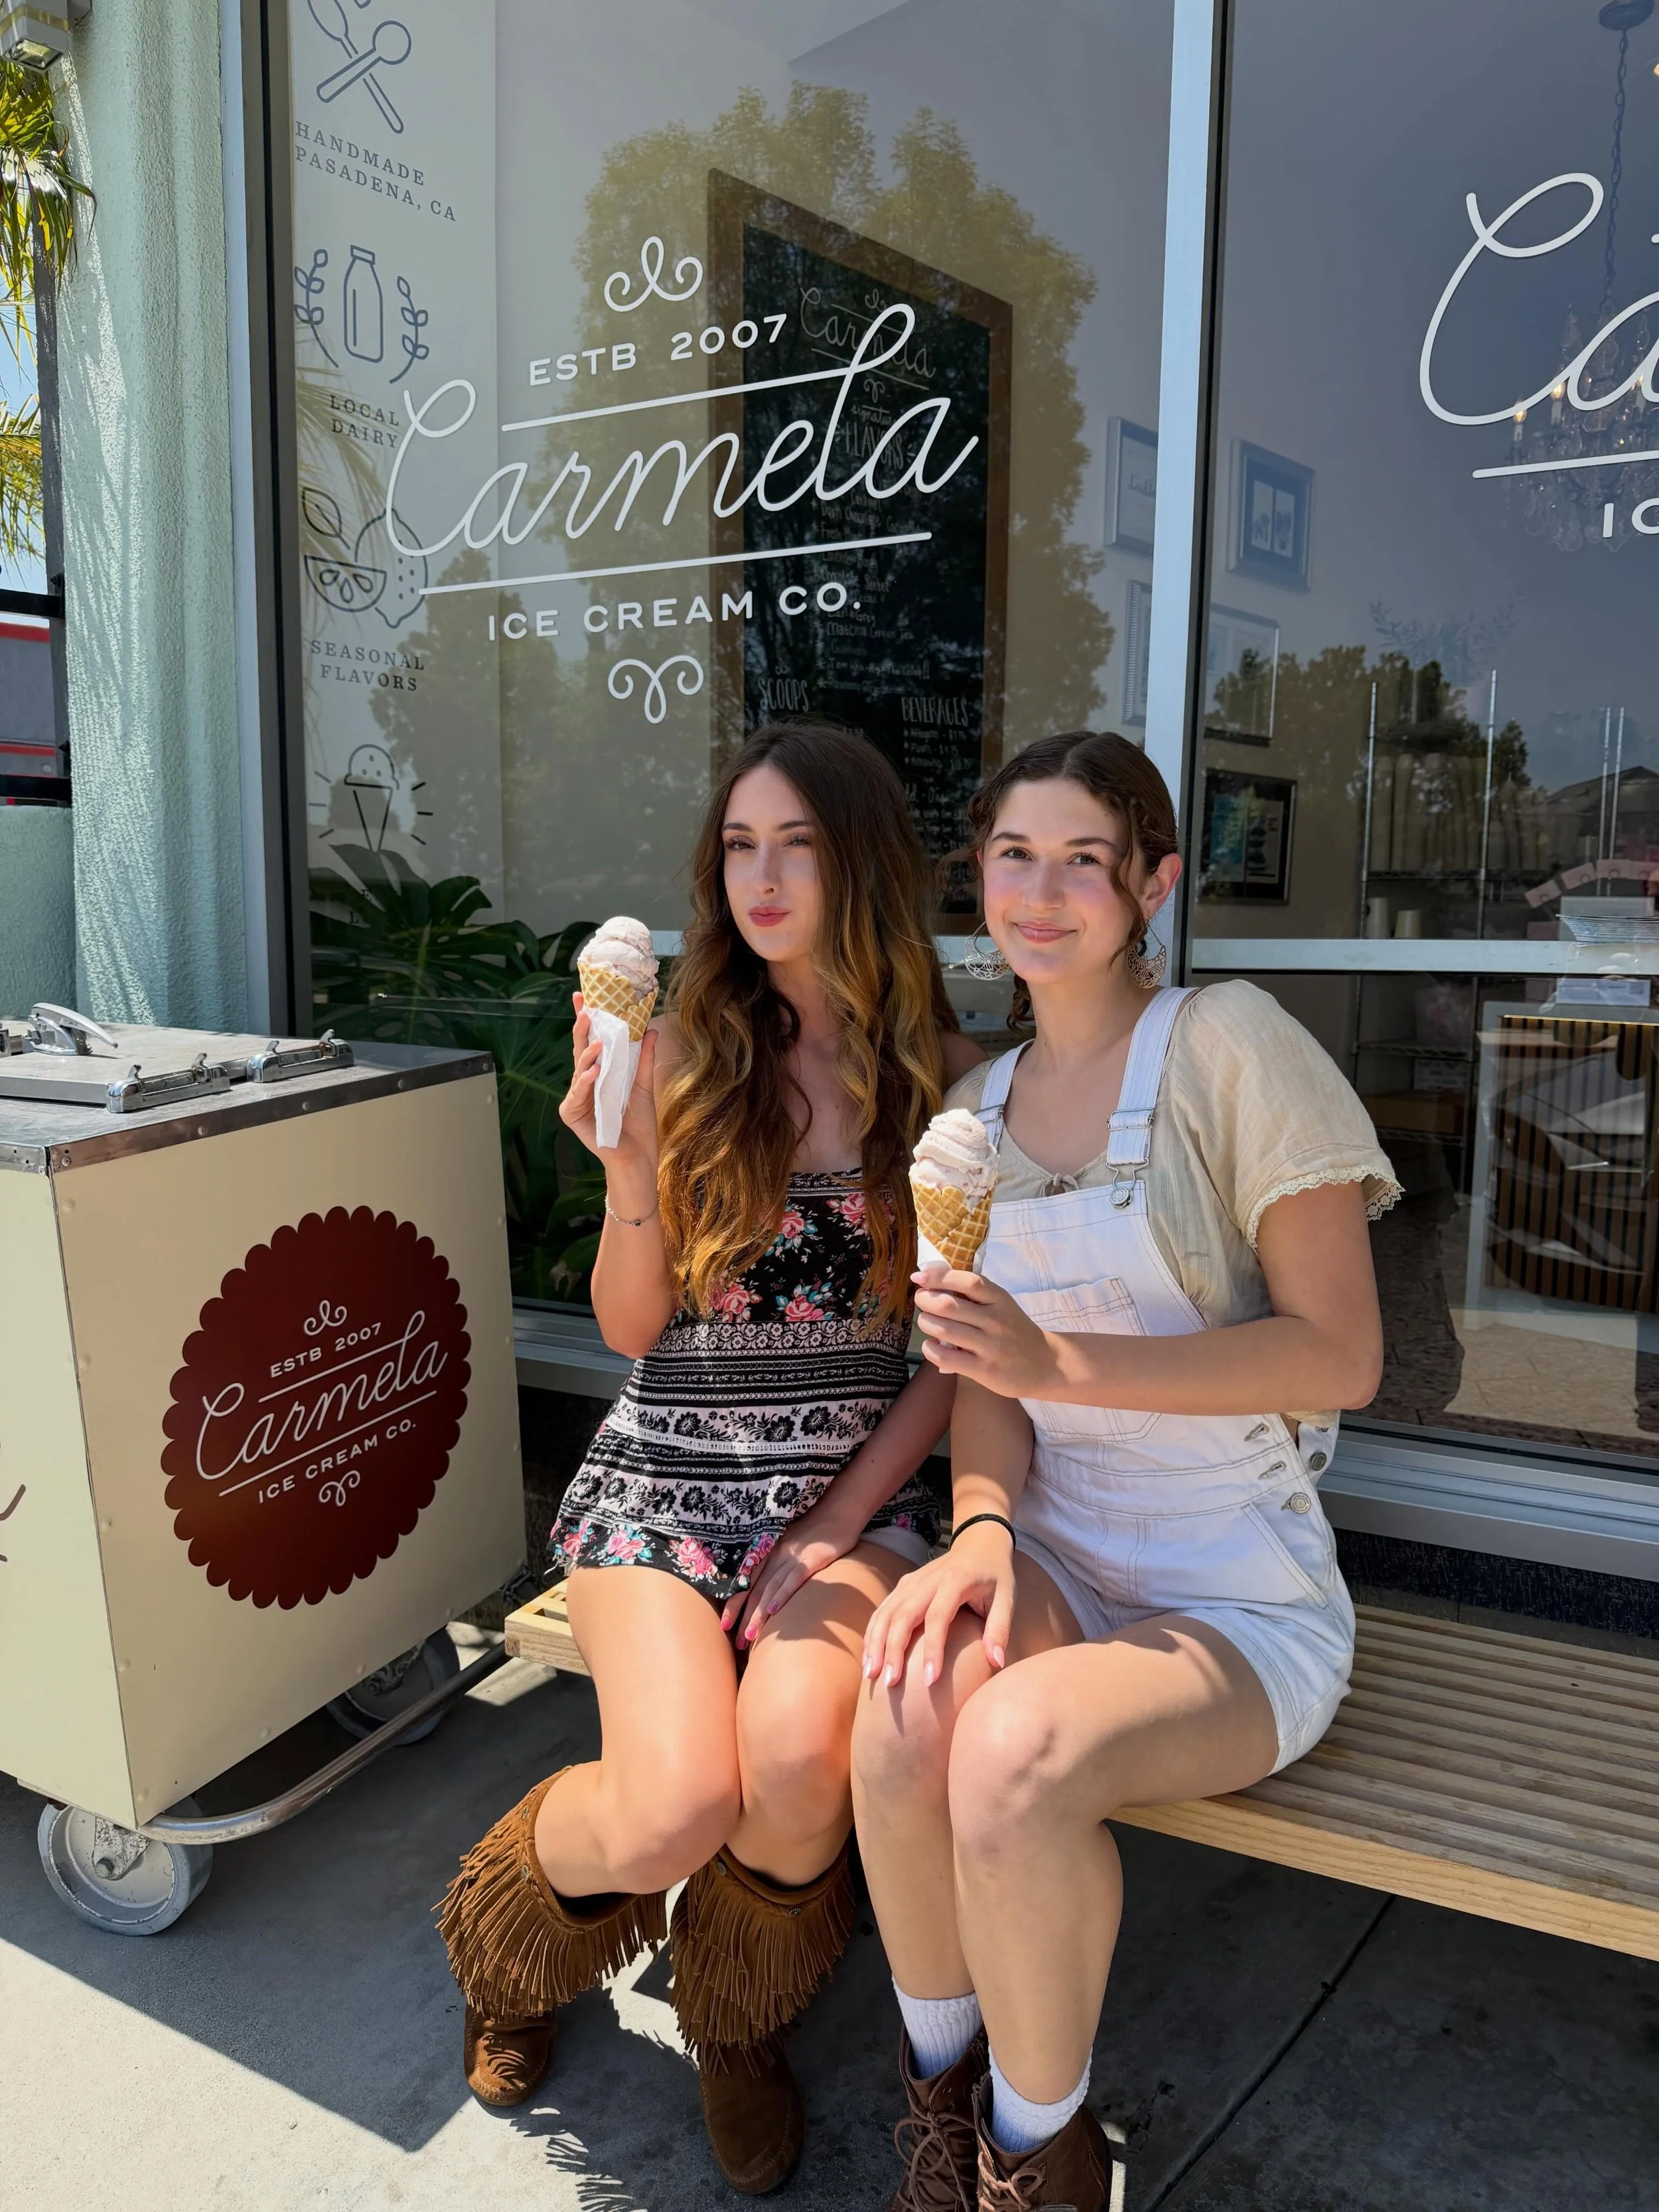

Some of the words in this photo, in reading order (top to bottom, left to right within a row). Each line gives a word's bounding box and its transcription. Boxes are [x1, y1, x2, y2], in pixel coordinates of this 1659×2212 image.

[295, 121, 424, 186] HANDMADE
[295, 145, 421, 210] PASADENA,
[431, 200, 456, 221] CA
[530, 342, 636, 386] ESTB
[670, 314, 787, 360] 2007
[330, 395, 399, 426] LOCAL
[332, 419, 397, 448] DAIRY
[386, 304, 978, 556] Carmela
[490, 610, 558, 640] ICE
[584, 591, 753, 632] CREAM
[779, 582, 860, 615] CO.
[311, 640, 424, 670] SEASONAL
[321, 664, 417, 691] FLAVORS
[758, 678, 809, 712] SCOOPS
[271, 1348, 322, 1378] ESTB
[335, 1323, 382, 1352] 2007
[196, 1311, 448, 1480] Carmela
[259, 1476, 295, 1503] ICE
[306, 1436, 377, 1480] CREAM
[386, 1419, 416, 1439] CO.
